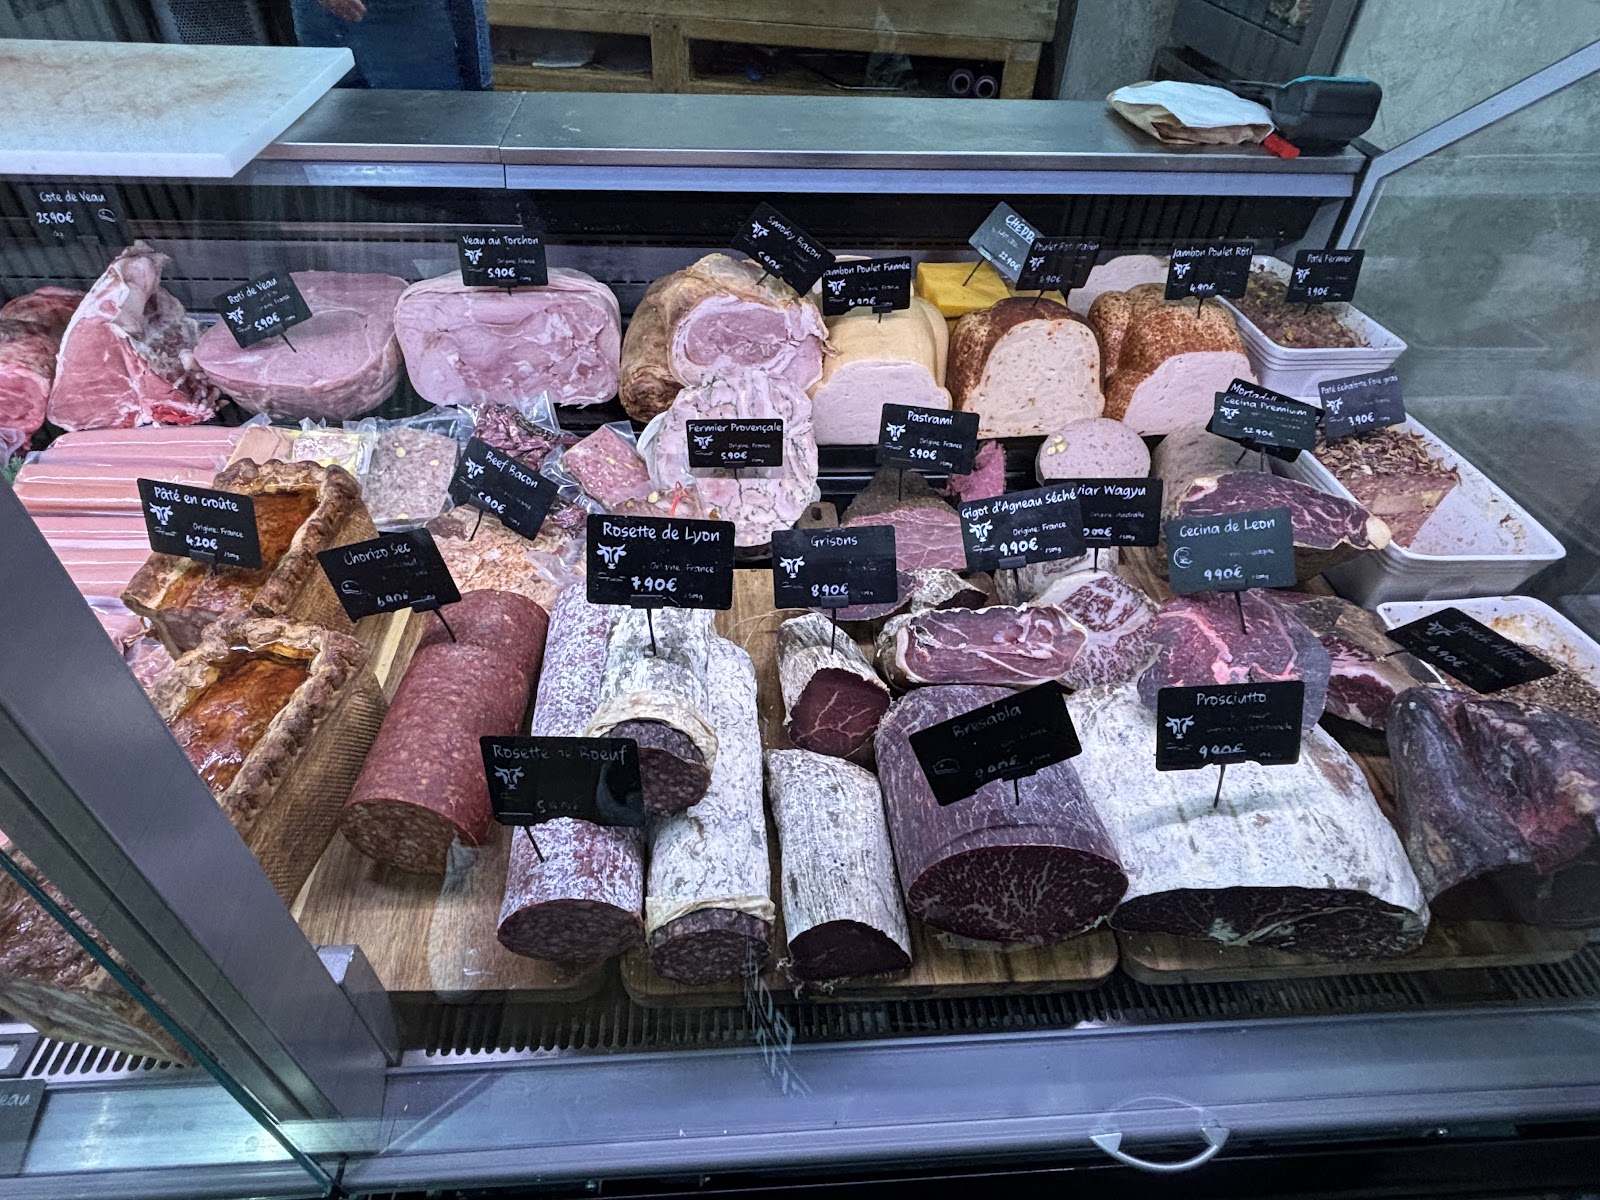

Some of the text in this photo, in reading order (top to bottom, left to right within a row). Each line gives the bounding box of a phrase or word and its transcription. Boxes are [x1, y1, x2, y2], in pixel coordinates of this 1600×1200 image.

[66, 191, 78, 202] de
[79, 192, 106, 202] Veau
[1005, 214, 1035, 241] CHEDD
[462, 235, 539, 245] Veau au Torchon
[766, 215, 822, 260] Smoky Bacon
[1172, 246, 1206, 259] Jambon
[1207, 246, 1233, 256] Poulet
[856, 262, 881, 273] Poulet
[883, 261, 911, 271] Fumée
[246, 285, 257, 297] de
[256, 277, 278, 291] Veau
[1223, 395, 1307, 416] Cecina Premium
[907, 410, 953, 427] Pastrami
[689, 422, 782, 434] Fermier Provençale
[943, 439, 963, 450] France
[485, 450, 539, 488] Beef Bacon
[1104, 484, 1147, 499] Wagyu
[154, 486, 239, 513] Pâté en croûte
[961, 486, 1077, 521] Gigot d'Agneau Séché
[220, 527, 245, 539] France
[602, 521, 720, 545] Rosette de Lyon
[1041, 521, 1067, 532] France
[1179, 518, 1276, 538] Cecina de Leon
[810, 535, 859, 548] Grisons
[344, 547, 389, 566] Chorizo
[390, 541, 411, 556] Sec
[686, 564, 715, 573] France
[1196, 692, 1267, 706] Prosciutto
[952, 704, 1023, 737] Bresaola
[493, 744, 550, 759] Rosette
